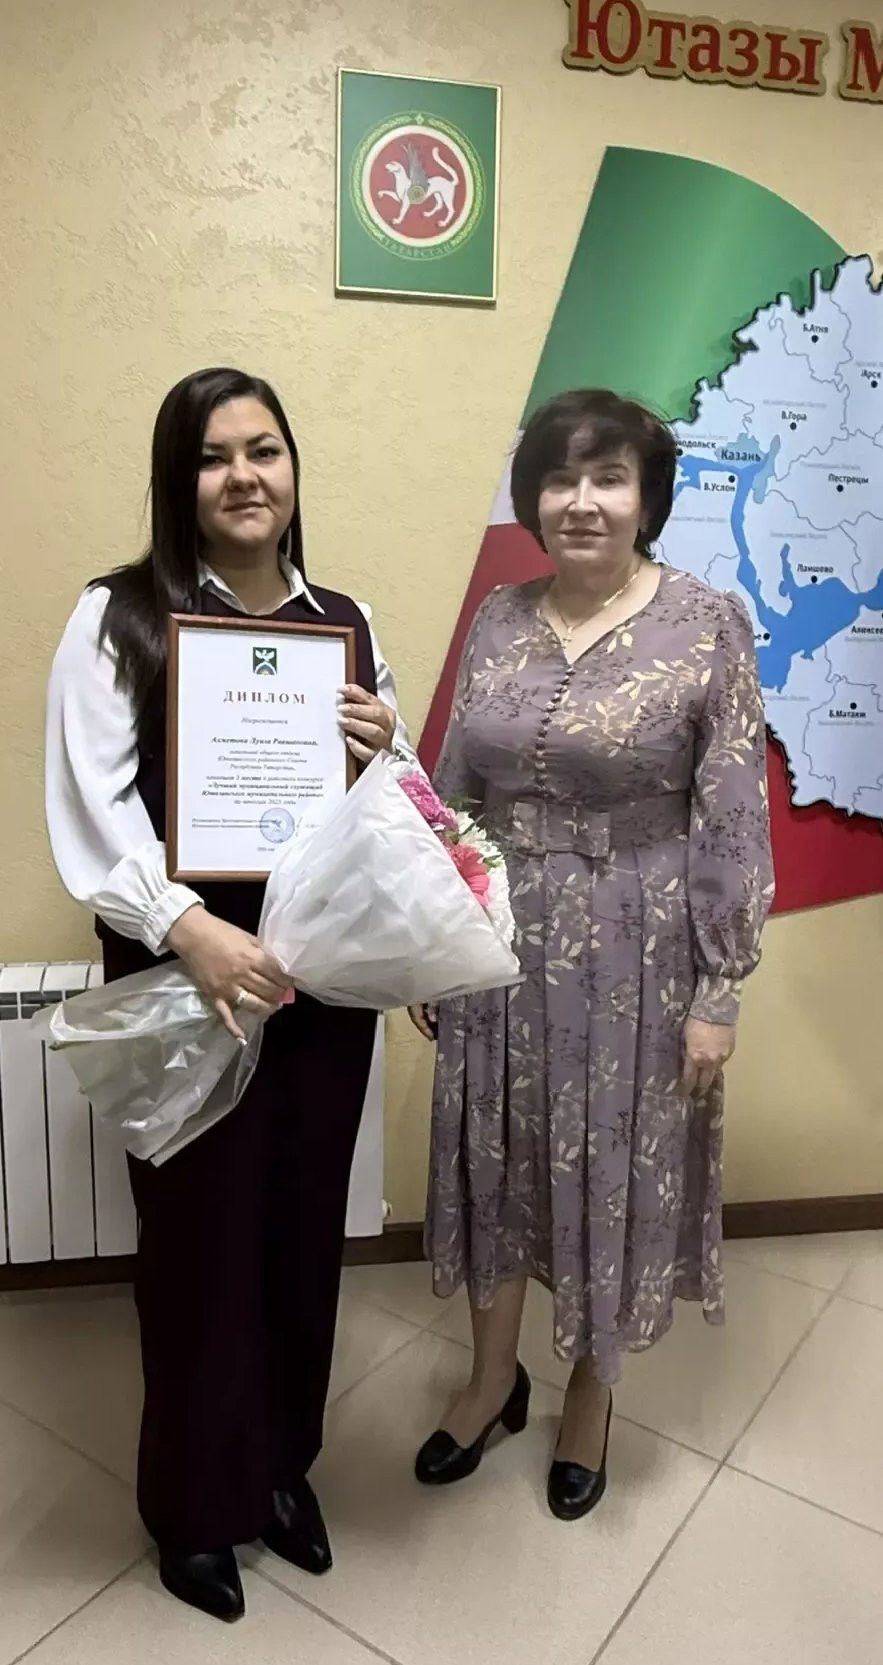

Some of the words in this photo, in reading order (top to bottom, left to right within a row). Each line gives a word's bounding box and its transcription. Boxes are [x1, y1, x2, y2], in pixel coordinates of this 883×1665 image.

[570, 0, 823, 85] Ютазы
[803, 323, 829, 333] Б.Атня
[721, 450, 761, 462] Казань
[828, 473, 869, 484] Пестрецы
[704, 482, 735, 492] В.Услон
[223, 690, 305, 704] ДИПЛОМ
